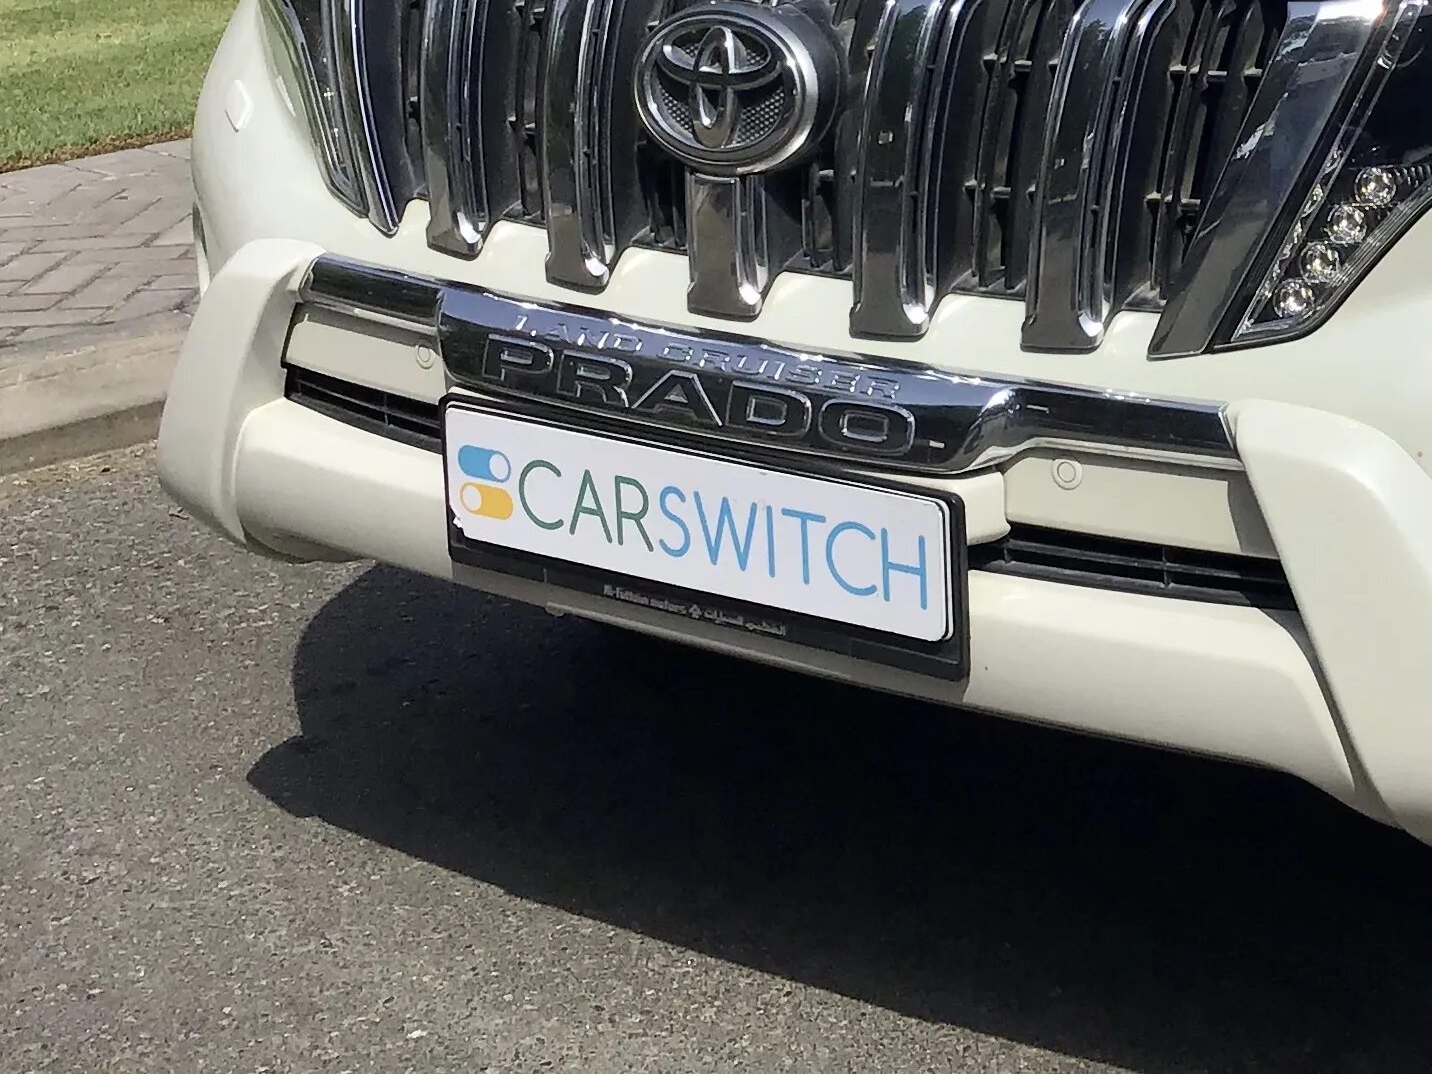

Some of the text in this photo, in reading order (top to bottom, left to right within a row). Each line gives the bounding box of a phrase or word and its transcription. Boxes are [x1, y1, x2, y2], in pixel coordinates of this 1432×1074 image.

[482, 333, 916, 456] PRADO
[513, 314, 901, 400] LAND CRUISER
[518, 459, 928, 611] CARSWITCH
